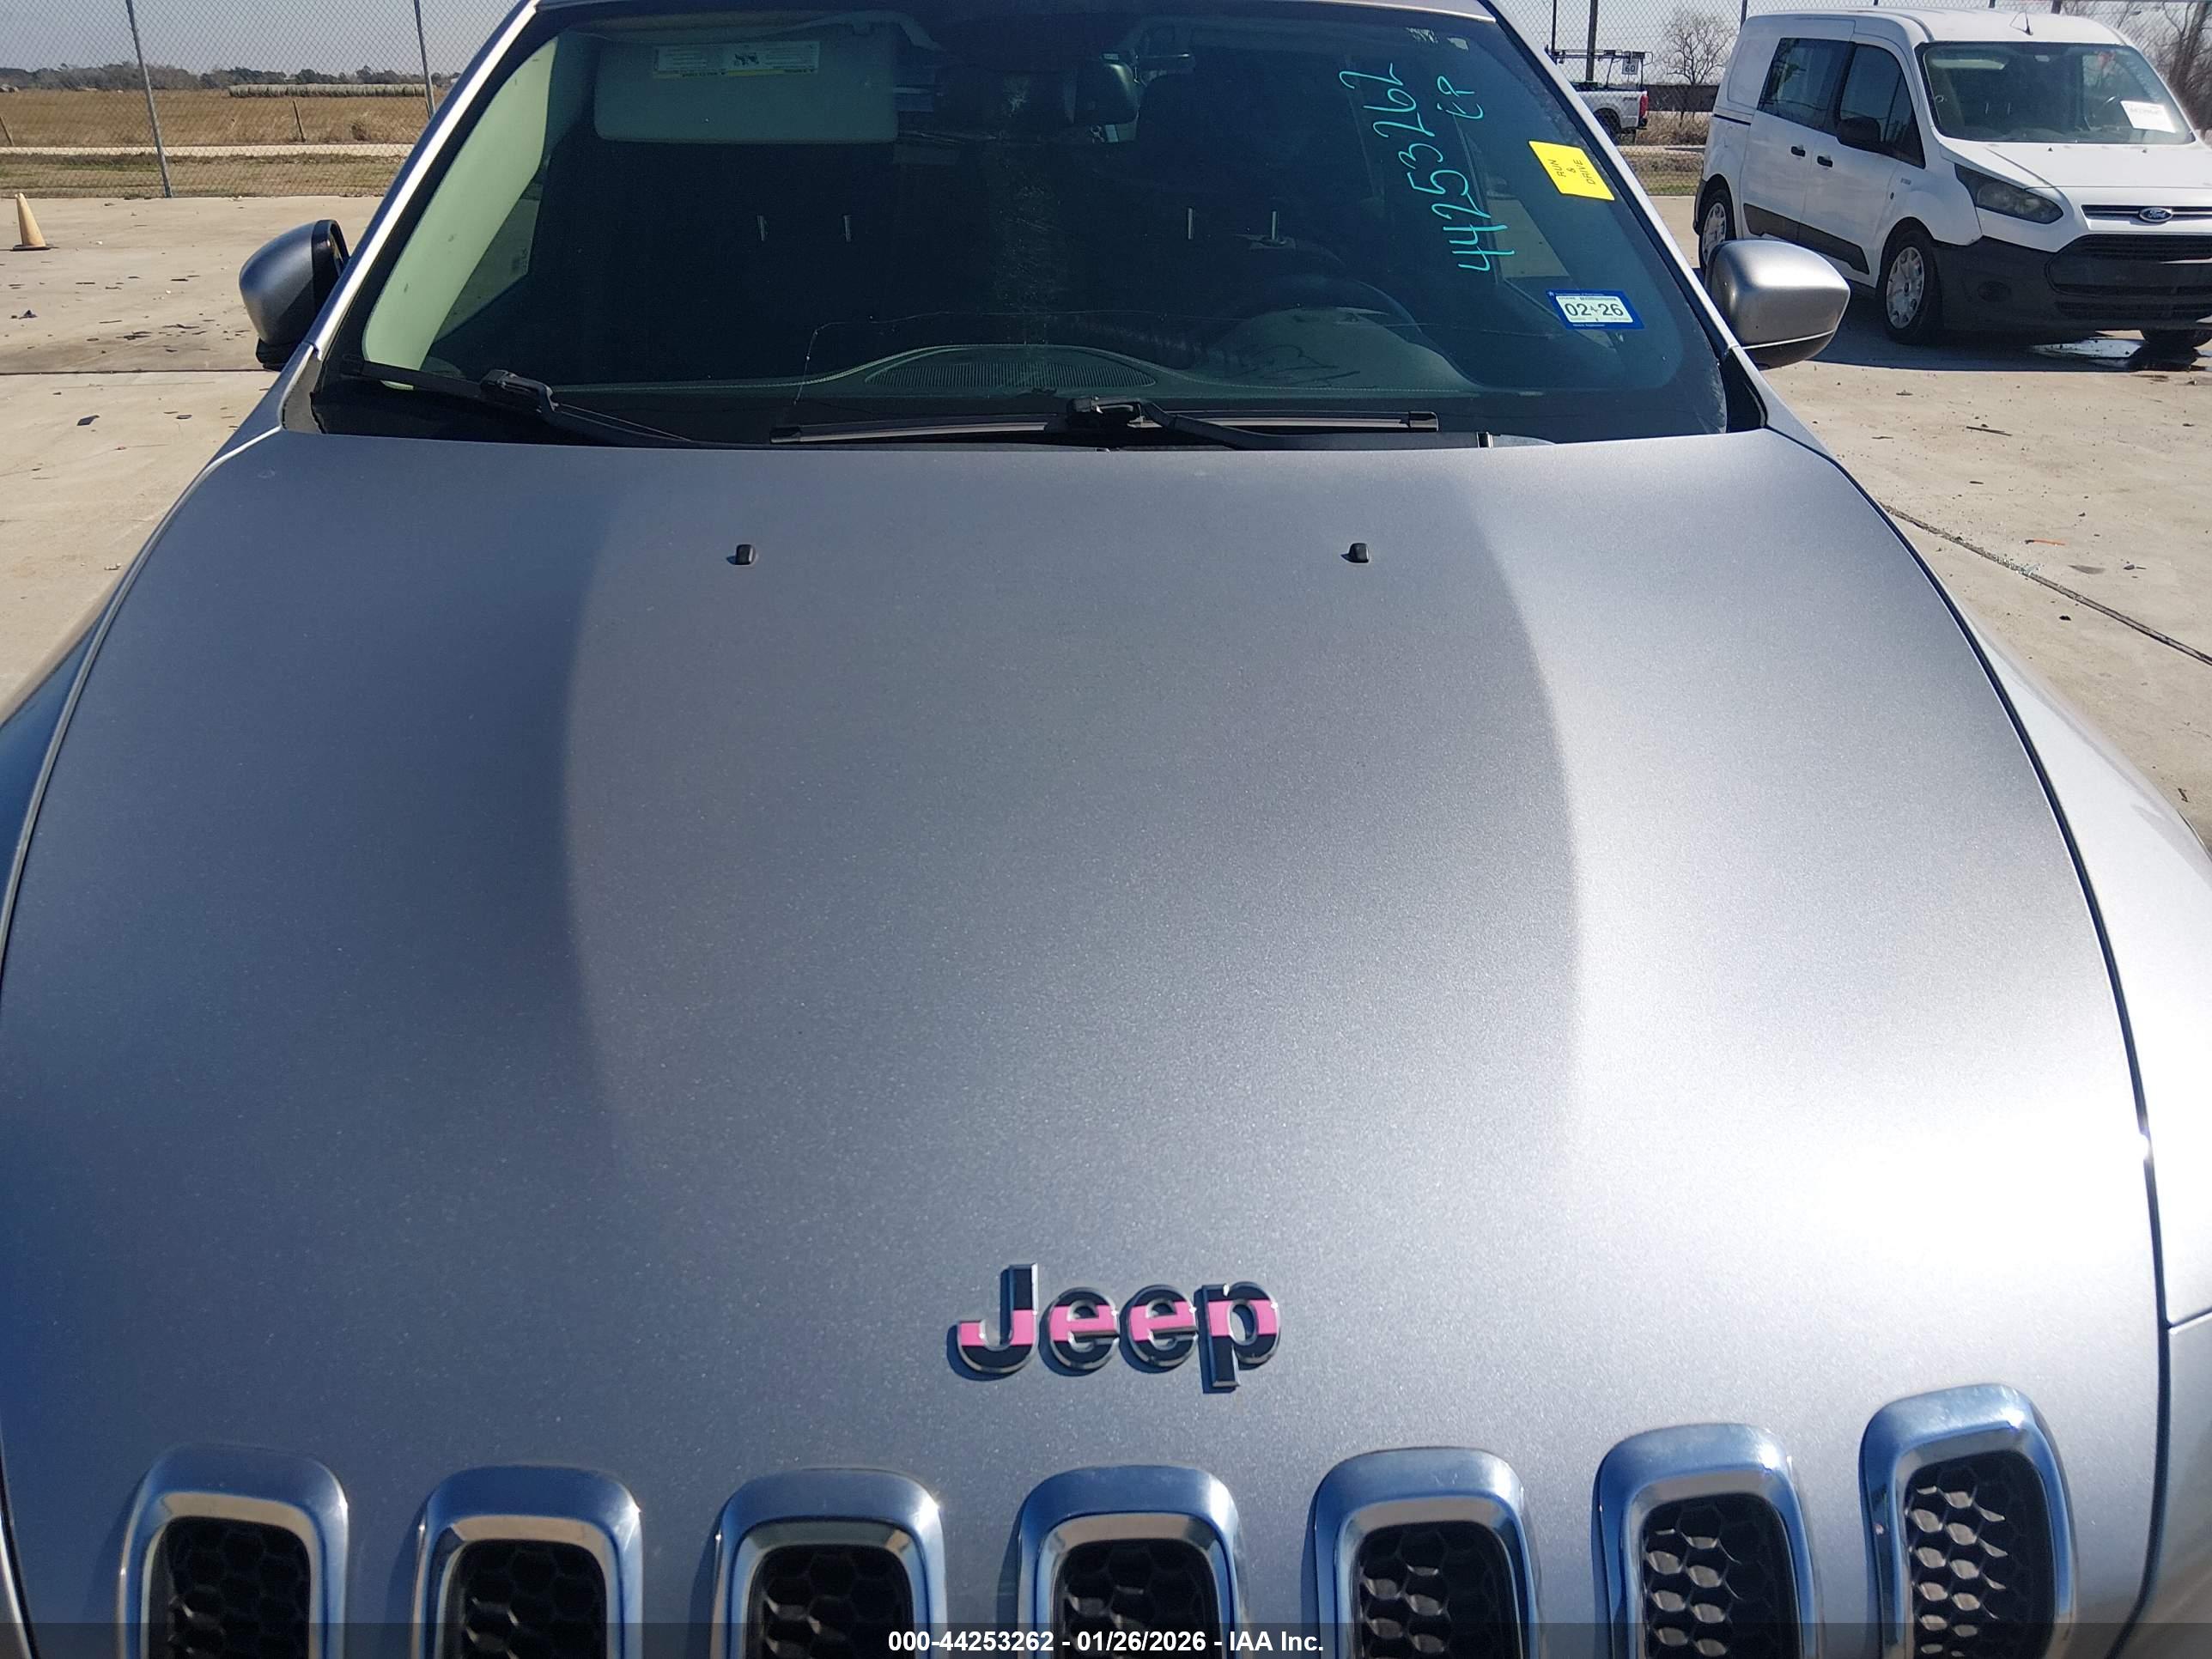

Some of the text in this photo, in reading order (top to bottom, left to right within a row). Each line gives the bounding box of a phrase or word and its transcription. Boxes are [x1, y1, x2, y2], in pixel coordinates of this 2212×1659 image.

[1625, 64, 1636, 73] 60
[1339, 62, 1516, 271] 44253262
[1547, 159, 1567, 178] RUN
[1573, 159, 1596, 185] DRIVE
[950, 1262, 1281, 1391] Jeep
